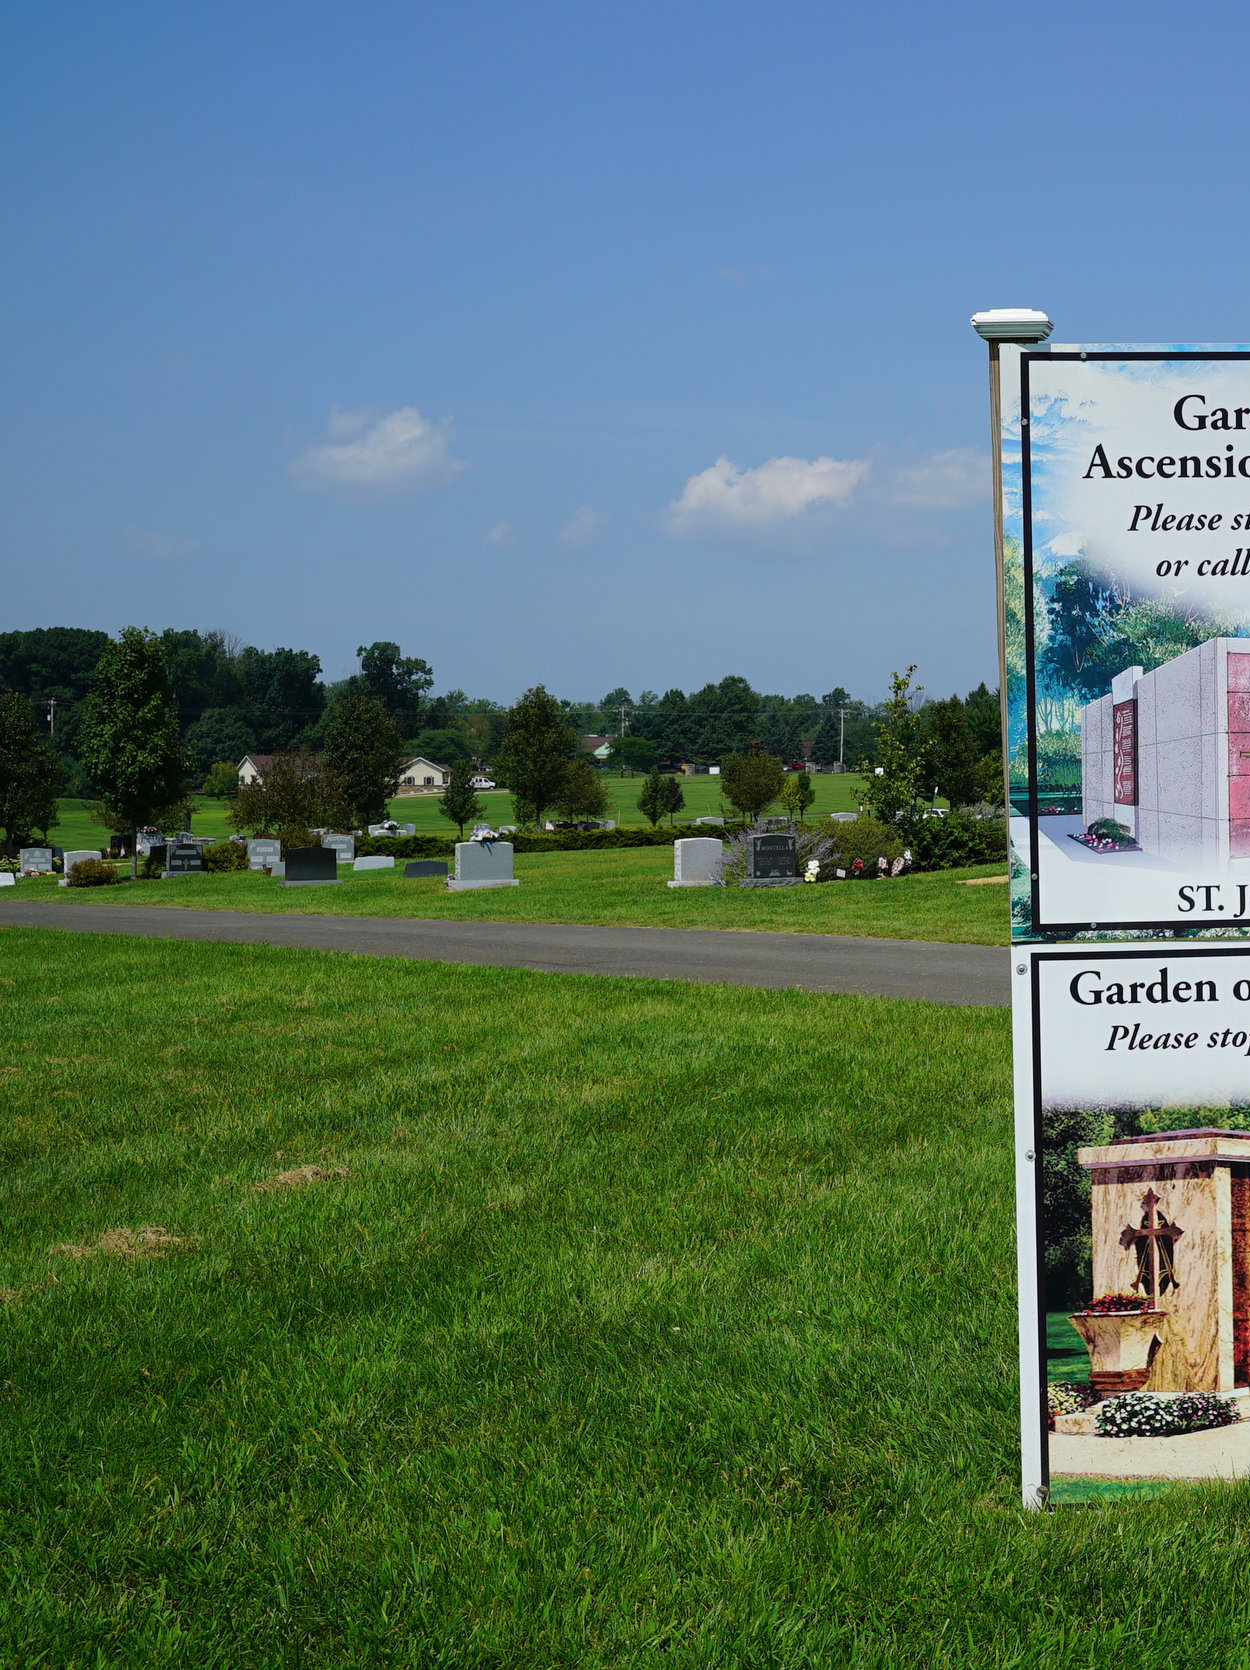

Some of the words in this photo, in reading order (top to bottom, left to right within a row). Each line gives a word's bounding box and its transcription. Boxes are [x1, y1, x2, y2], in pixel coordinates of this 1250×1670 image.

[1127, 503, 1222, 531] Please
[1156, 560, 1189, 576] or
[1178, 885, 1224, 912] ST.
[1070, 967, 1219, 1005] Garden
[1105, 1023, 1198, 1050] Please
